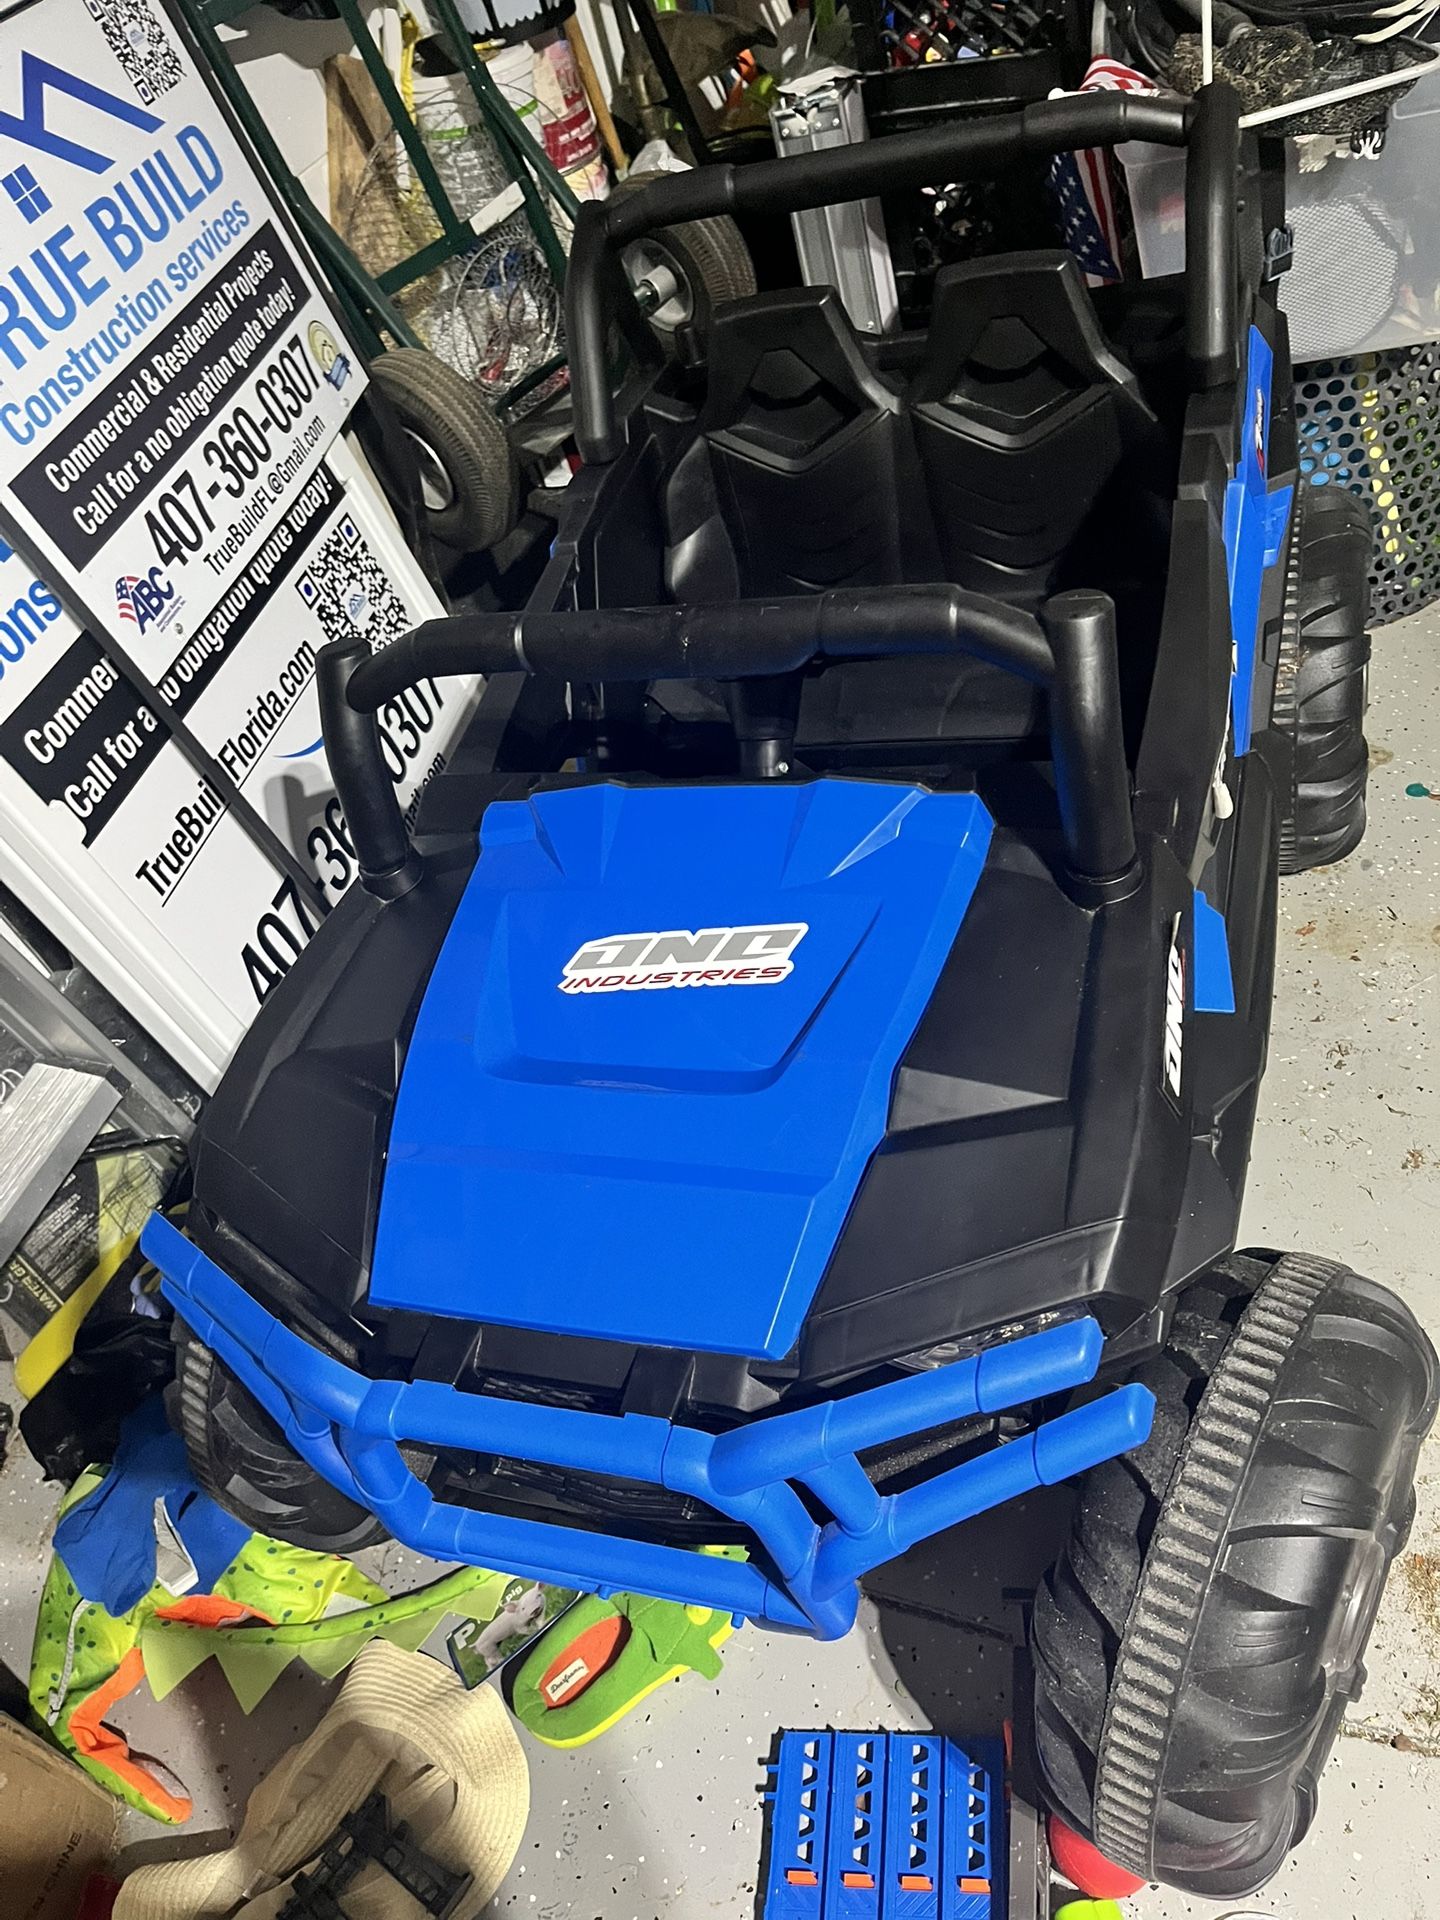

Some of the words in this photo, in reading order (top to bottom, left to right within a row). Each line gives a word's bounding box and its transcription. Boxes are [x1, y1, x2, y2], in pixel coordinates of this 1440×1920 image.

[0, 224, 111, 374] RUE
[84, 125, 224, 273] BUILD
[221, 249, 275, 308] Projects
[0, 278, 174, 446] Construction
[166, 199, 250, 292] services
[151, 291, 231, 384] Residential
[45, 379, 151, 493] Commercial
[72, 483, 118, 536] Call
[107, 461, 141, 500] for
[135, 450, 153, 474] a
[145, 429, 172, 461] no
[165, 358, 236, 445] obligation
[229, 315, 265, 369] quote
[256, 277, 297, 323] today!
[140, 369, 164, 396] &
[144, 333, 320, 567] 407-360-0307
[203, 415, 327, 576] TrueBuildFL@Gmail.com
[131, 566, 174, 635] ABC
[63, 752, 117, 818] Call
[103, 718, 143, 769] for
[137, 704, 158, 733] a
[563, 966, 787, 989] INDUSTRIES
[505, 1584, 524, 1603] pig
